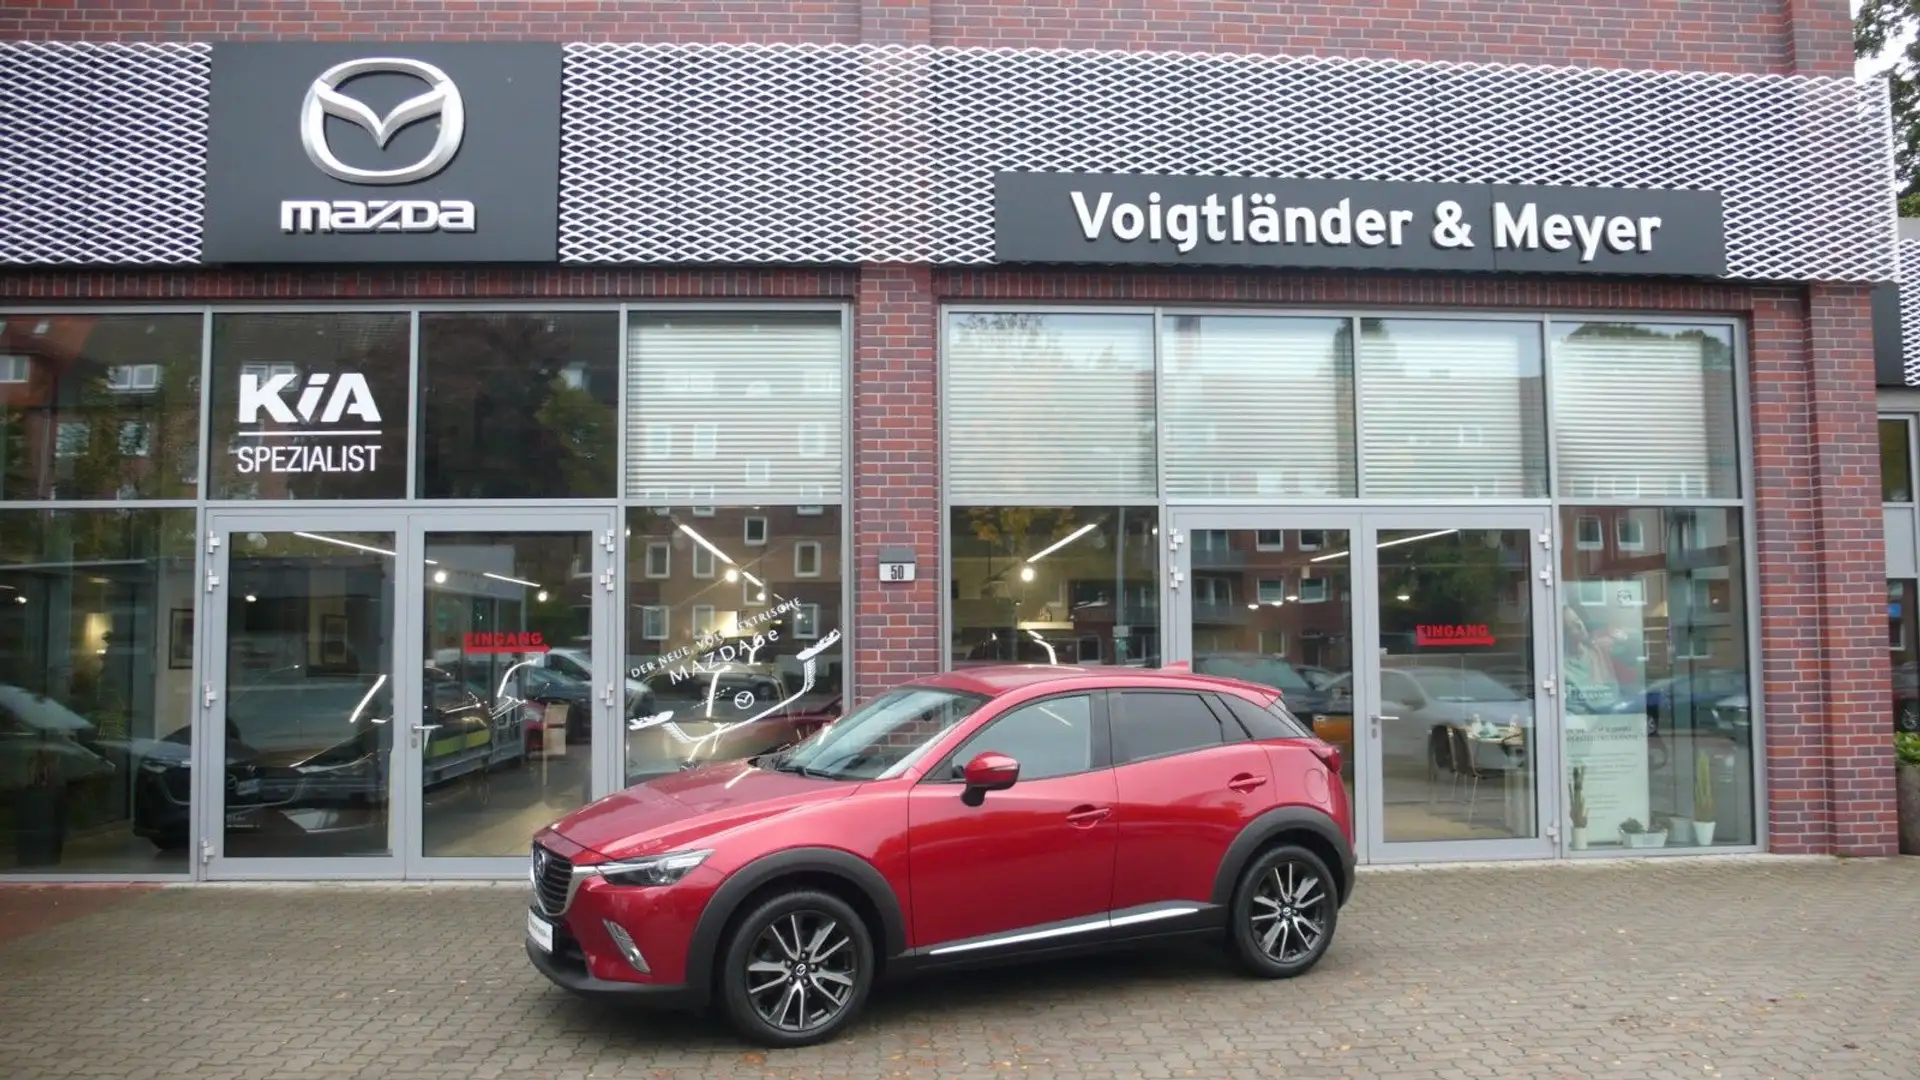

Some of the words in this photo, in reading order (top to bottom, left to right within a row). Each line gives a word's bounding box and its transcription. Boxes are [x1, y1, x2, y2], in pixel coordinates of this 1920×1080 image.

[1070, 191, 1414, 253] Voigtländer
[1432, 200, 1476, 249] &
[1492, 201, 1662, 263] Meyer
[236, 445, 382, 473] SPEZIALIST
[890, 564, 904, 580] 50
[1416, 623, 1488, 638] EINGANG
[464, 632, 544, 646] EINGANG
[630, 662, 657, 679] DER
